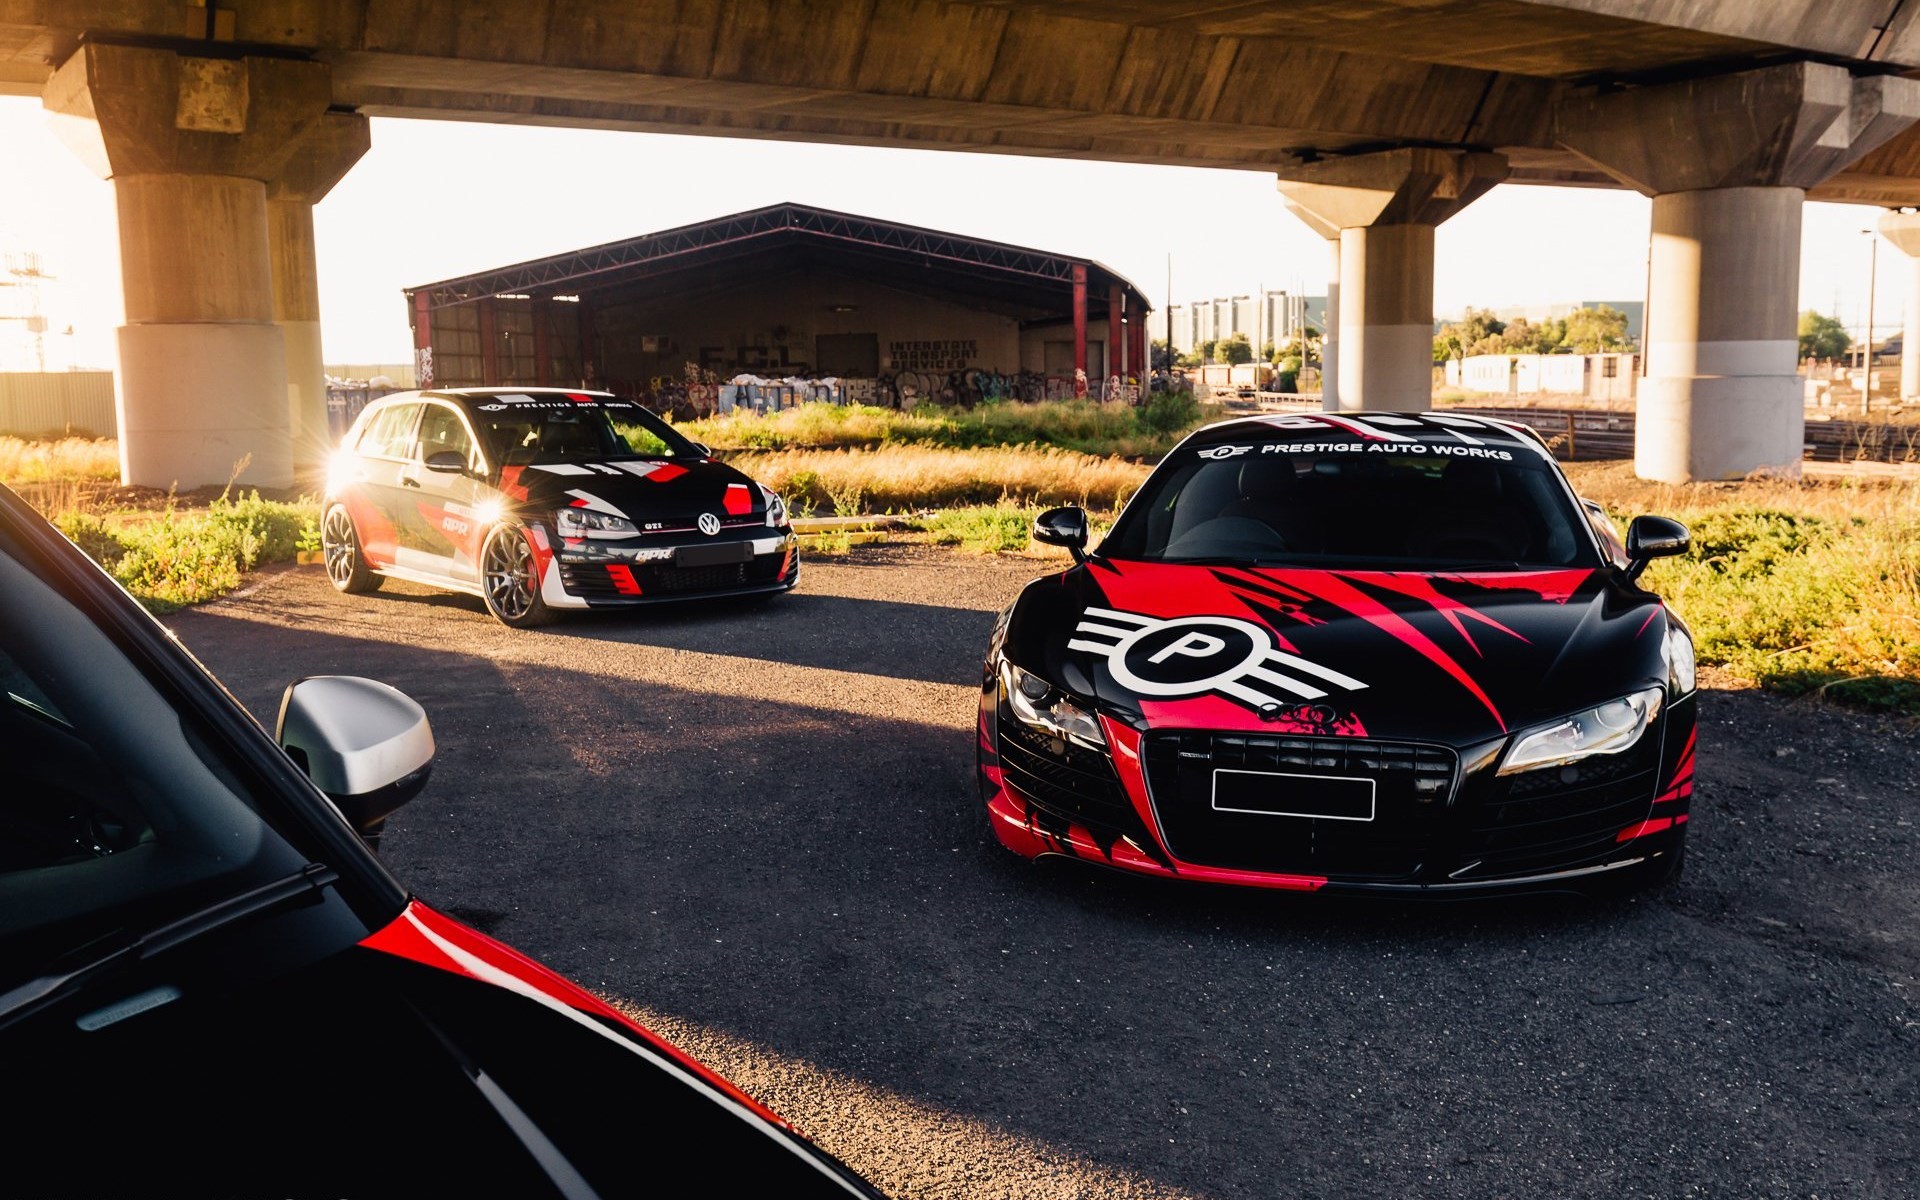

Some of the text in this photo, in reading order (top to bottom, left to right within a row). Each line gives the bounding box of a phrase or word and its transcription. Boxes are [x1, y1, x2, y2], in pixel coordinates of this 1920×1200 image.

[890, 340, 977, 351] INTERSTATE
[891, 350, 978, 360] TRANSPORT
[890, 360, 966, 369] SERVICES
[1261, 443, 1513, 461] PRESTIGE AUTO WORKS
[644, 522, 663, 530] GTI
[1147, 631, 1226, 665] P
